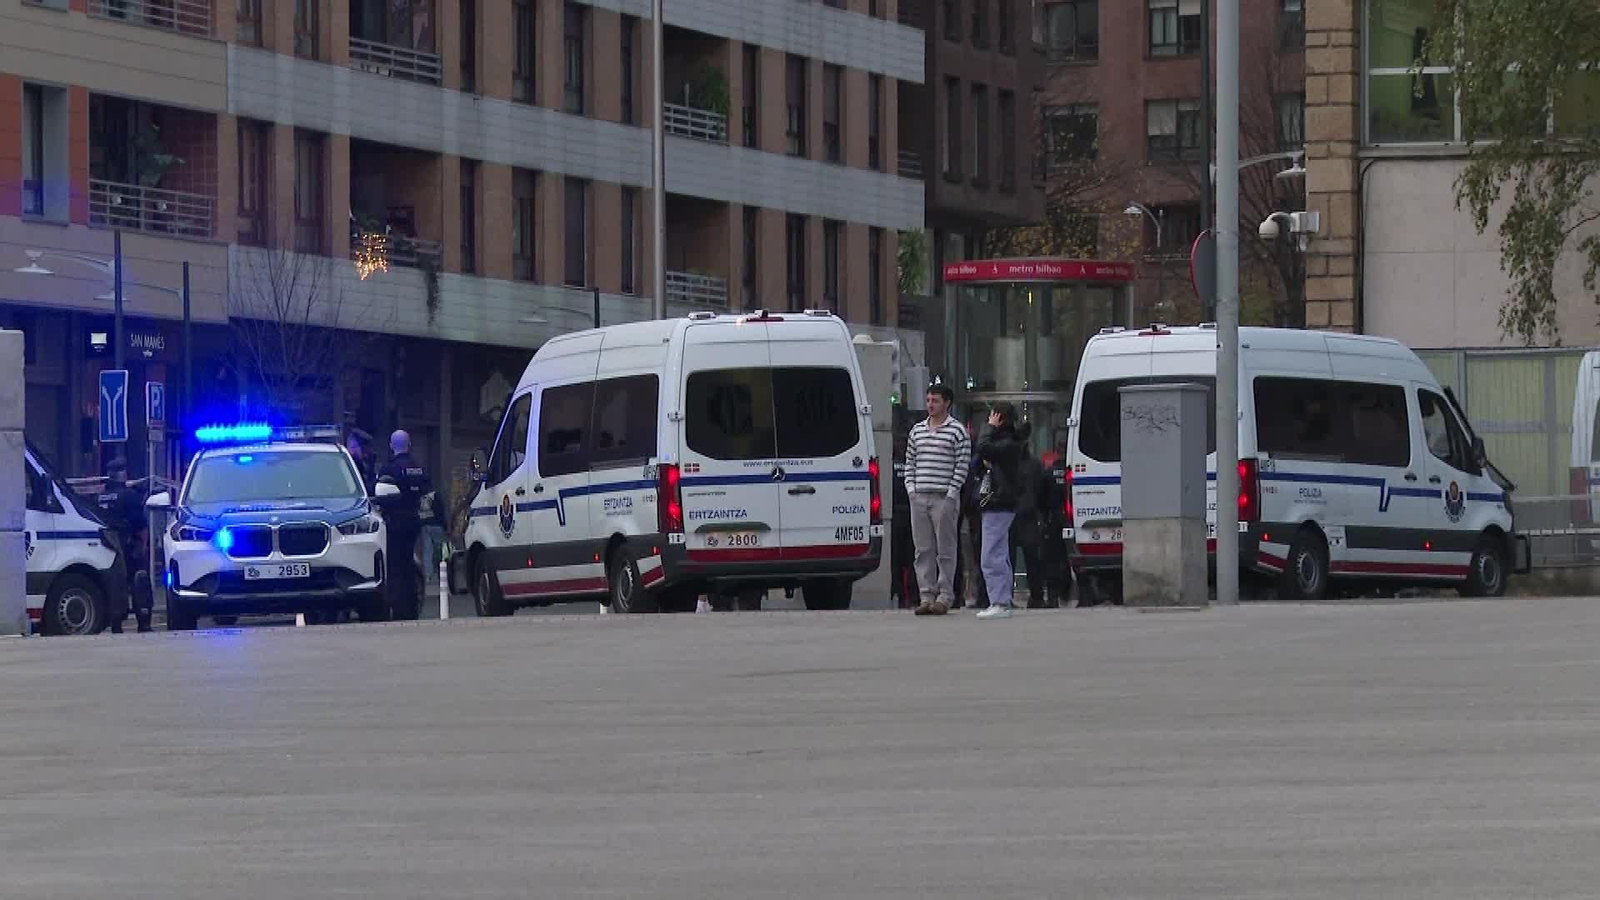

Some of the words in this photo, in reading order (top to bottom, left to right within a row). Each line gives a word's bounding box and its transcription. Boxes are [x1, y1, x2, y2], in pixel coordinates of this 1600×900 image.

[1009, 264, 1033, 274] metro
[1036, 263, 1062, 274] bilbao
[130, 333, 143, 348] SAN
[151, 386, 160, 418] P
[688, 509, 748, 520] ERTZAINTZA
[832, 506, 866, 514] POLIZIA
[834, 526, 864, 541] 4MF05
[727, 534, 758, 546] 2800
[278, 564, 308, 576] 2953
